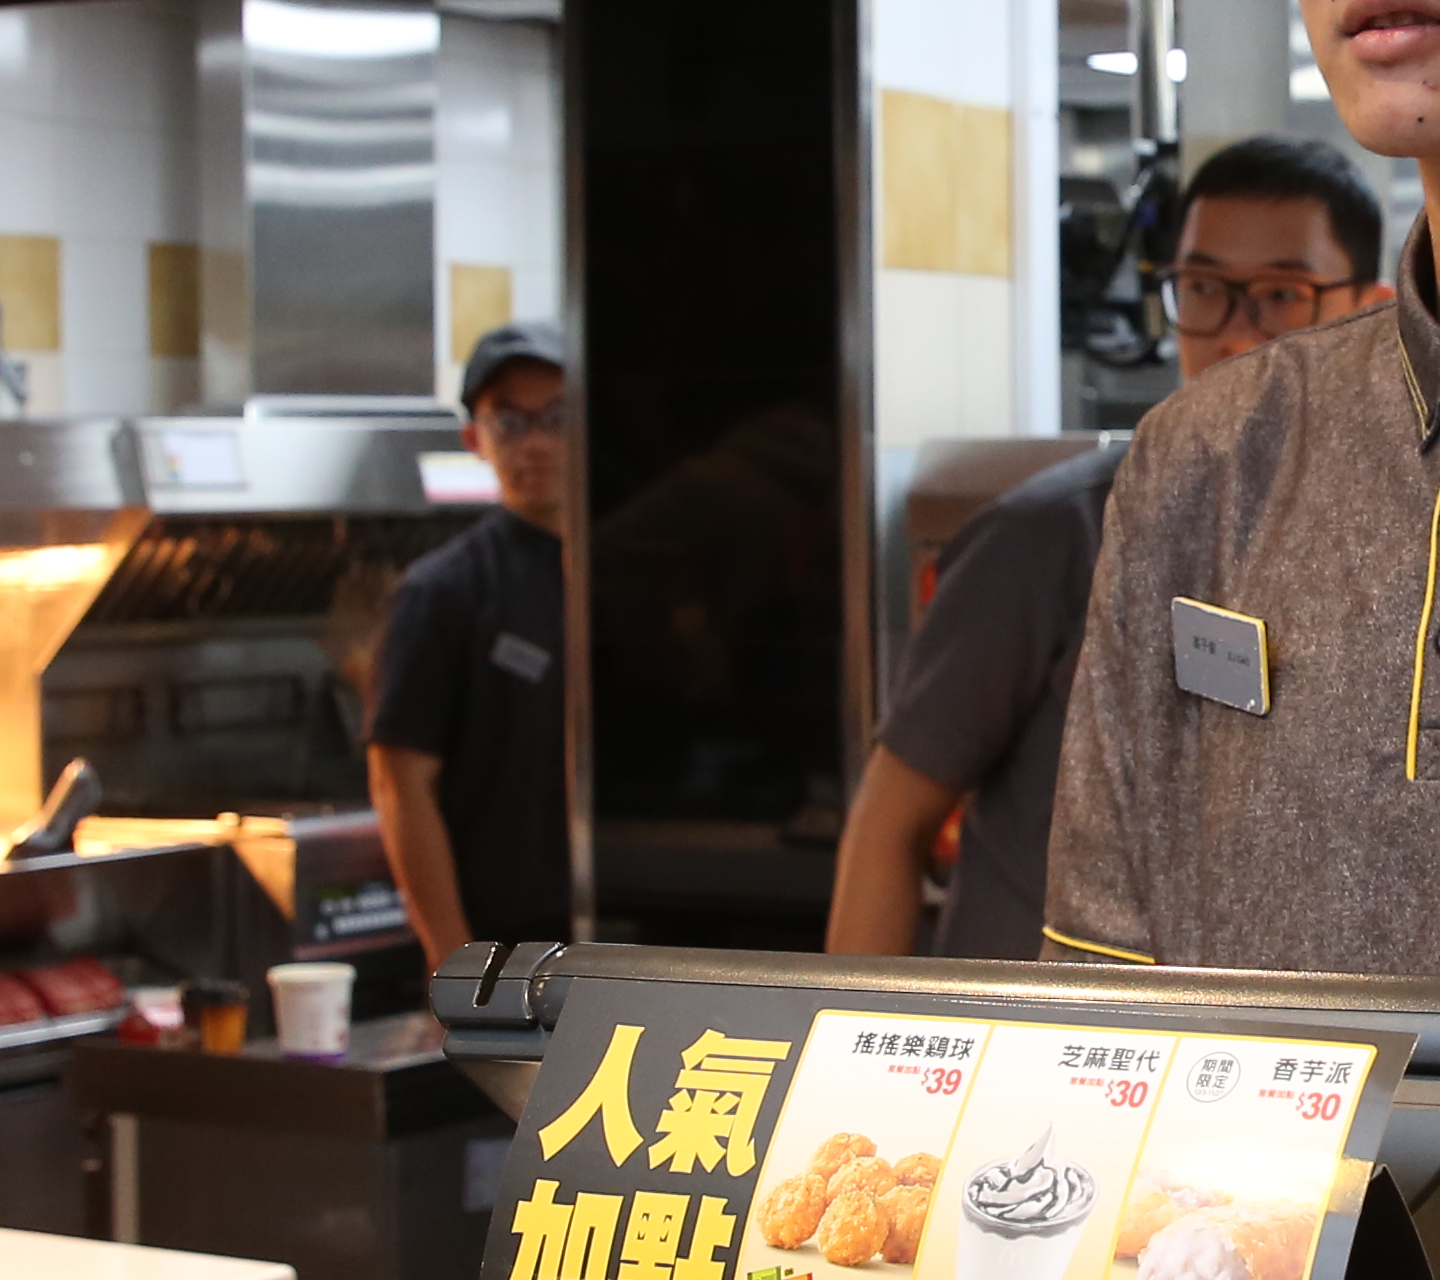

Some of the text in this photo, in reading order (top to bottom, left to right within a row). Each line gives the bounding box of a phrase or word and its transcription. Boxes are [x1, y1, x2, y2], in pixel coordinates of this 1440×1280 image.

[1057, 1044, 1161, 1074] 芝麻聖代
[1201, 1059, 1234, 1074] 期間
[1272, 1058, 1353, 1084] 香芋派
[921, 1067, 963, 1096] $39
[1105, 1079, 1149, 1108] $30
[1195, 1073, 1229, 1089] 限定
[538, 1023, 792, 1177] 人氣
[1295, 1091, 1342, 1121] $30
